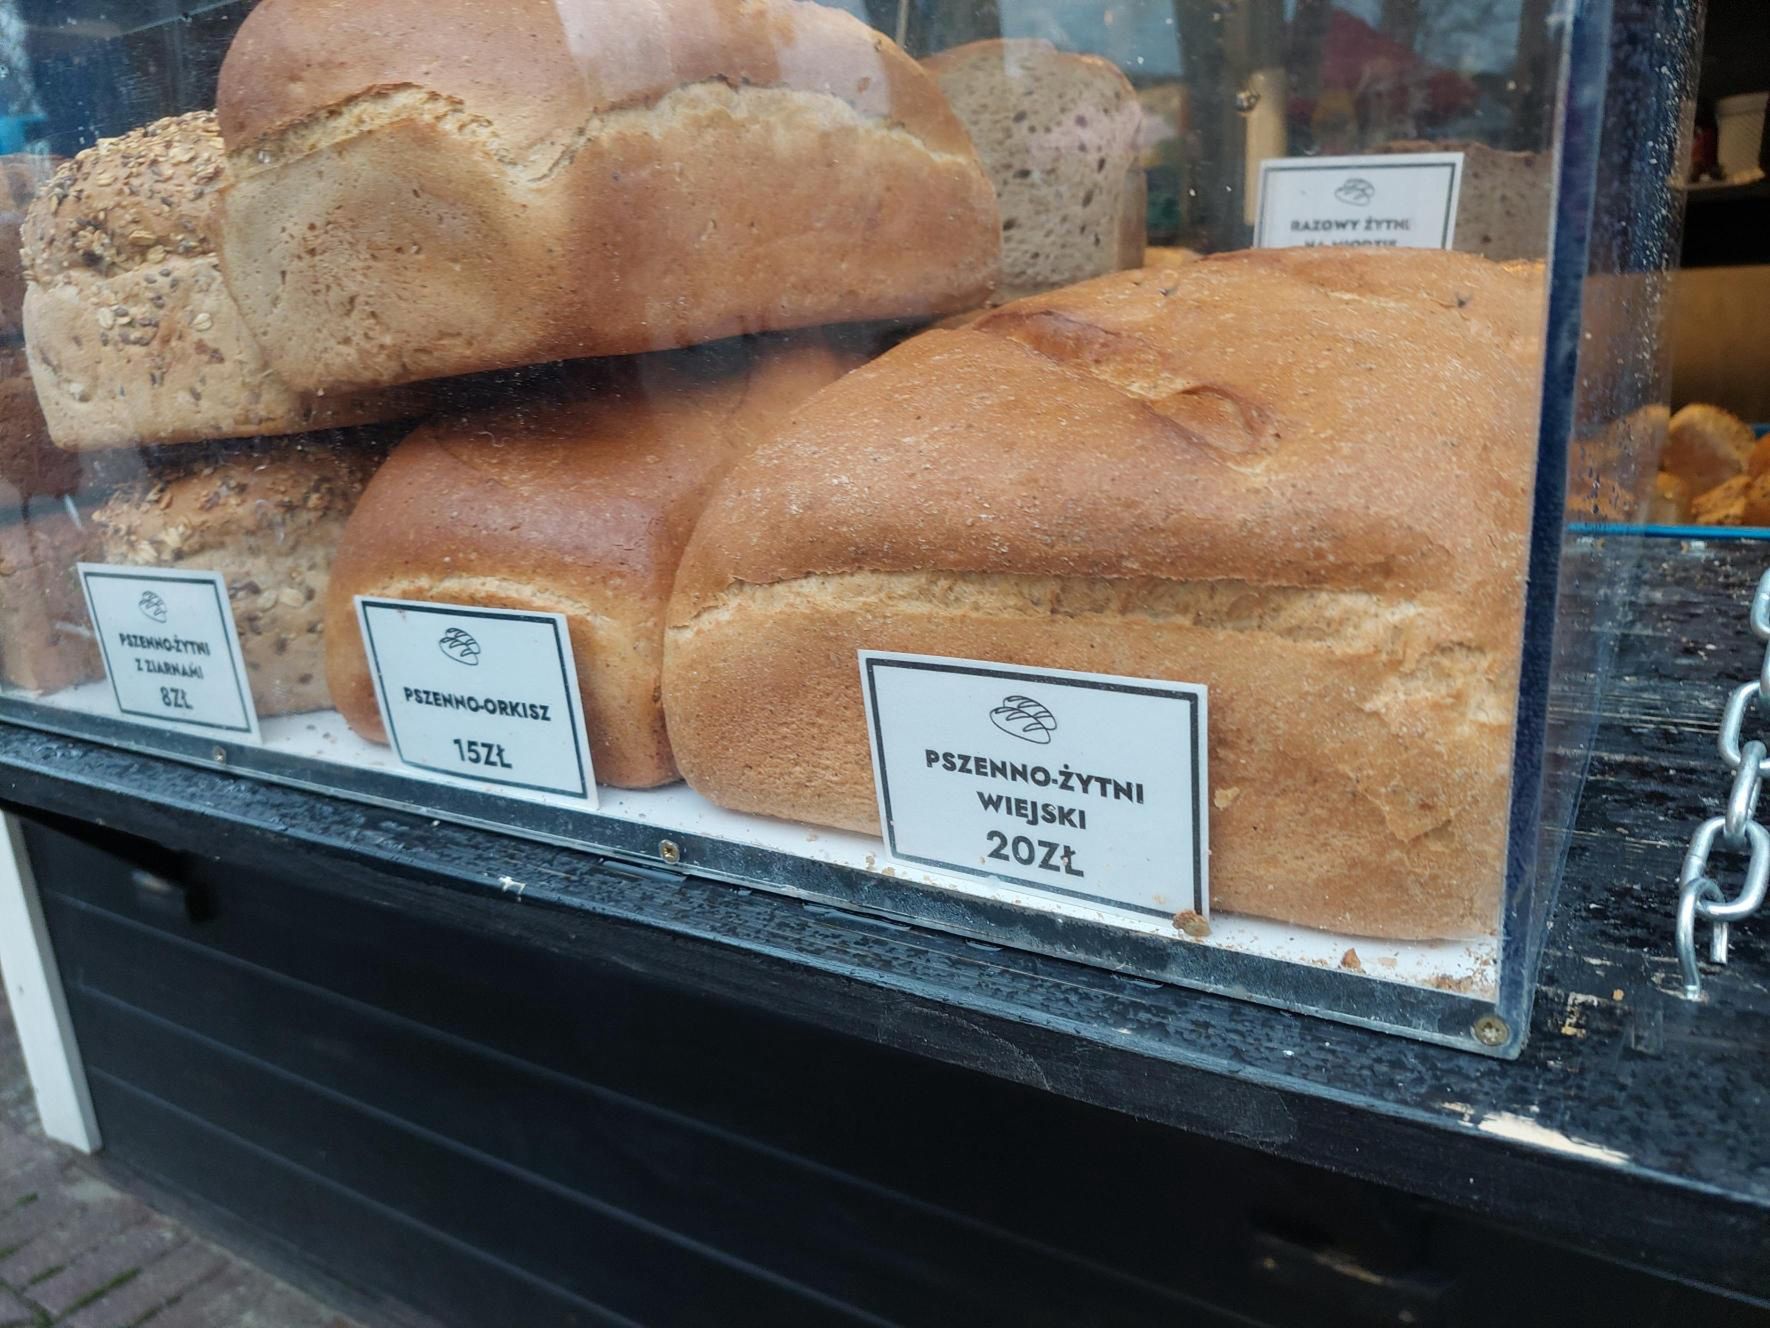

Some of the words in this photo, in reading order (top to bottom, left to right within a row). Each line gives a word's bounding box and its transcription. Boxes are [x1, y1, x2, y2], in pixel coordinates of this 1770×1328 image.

[119, 633, 211, 656] PSZENNO-ŻYTNI
[135, 658, 143, 671] Z
[145, 659, 204, 679] ZIARNAMI
[160, 686, 194, 710] 8ZŁ
[403, 686, 552, 721] PSZENNO-ORKISZ
[453, 738, 513, 769] 15ZŁ
[925, 748, 1145, 805] PSZENNO-ŻYTNI
[976, 791, 1087, 830] WIEJSKI
[986, 830, 1085, 878] 20ZŁ
